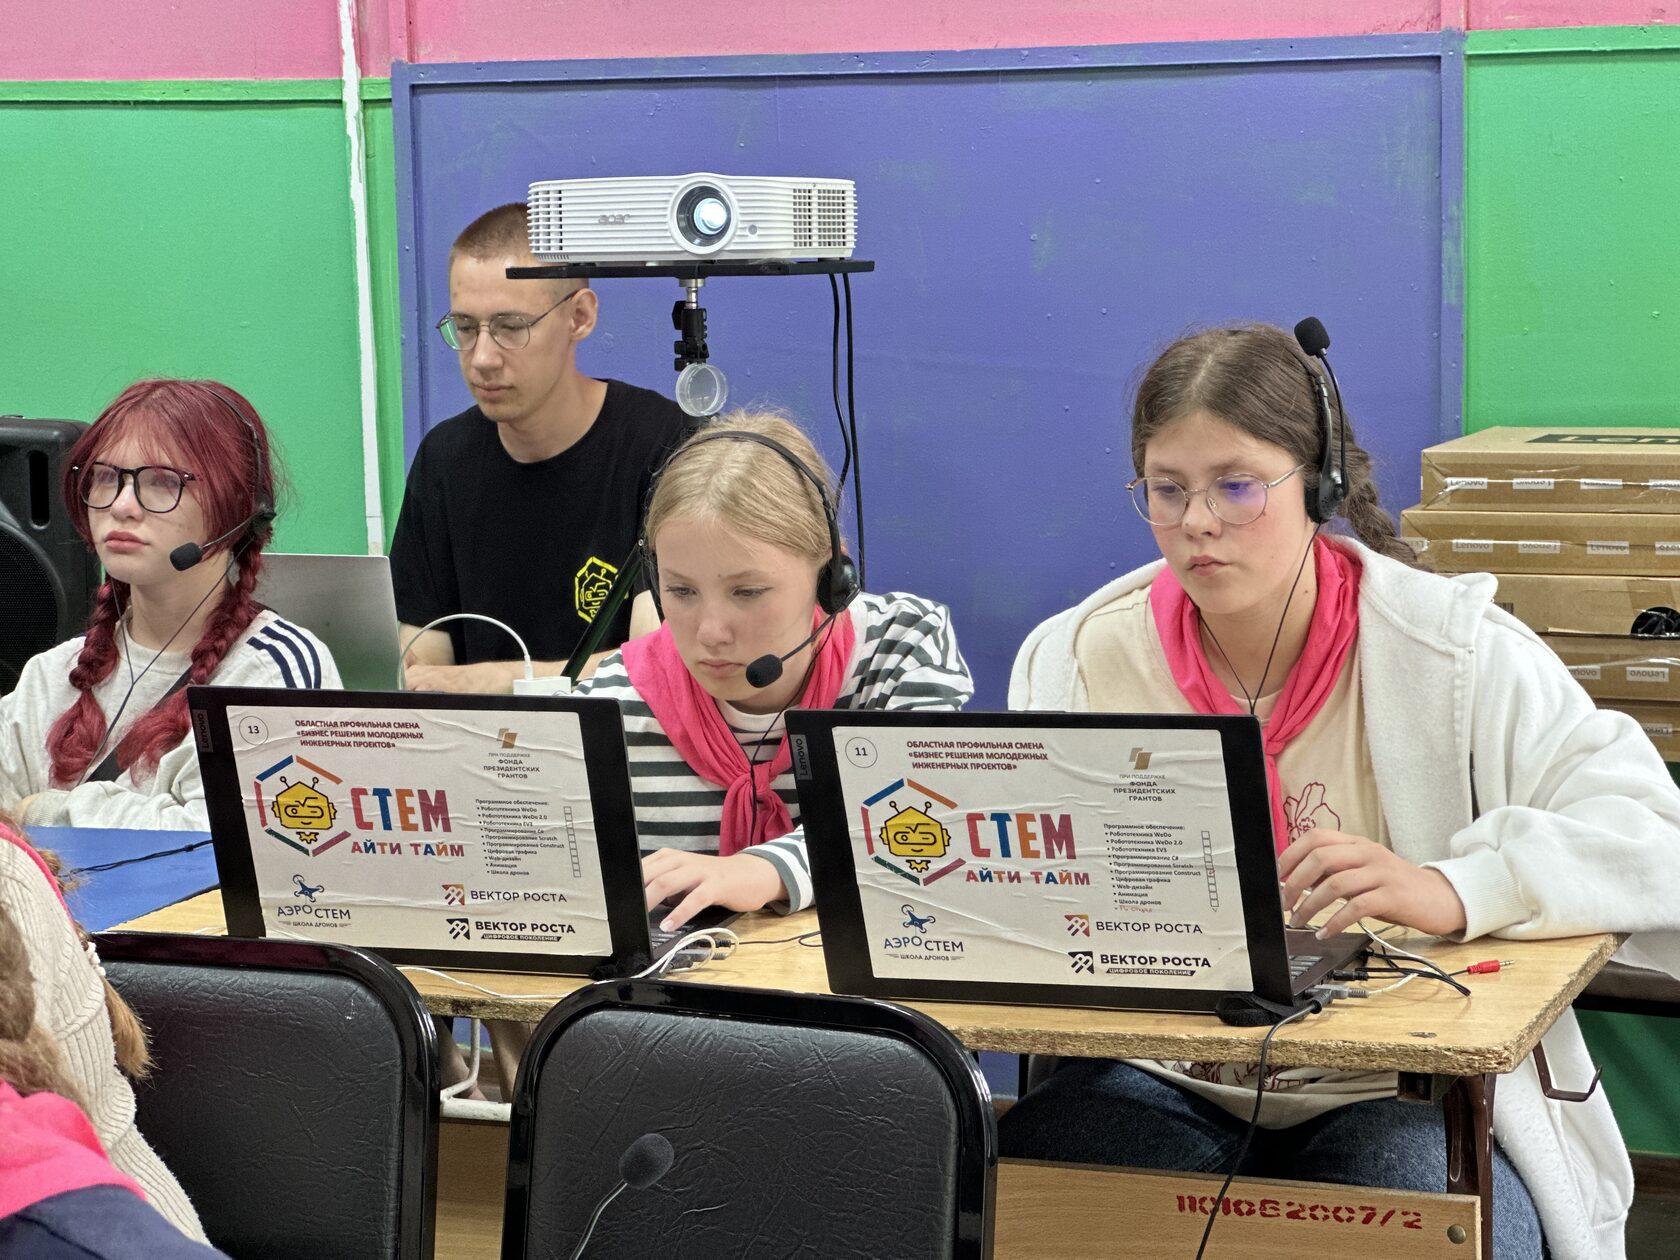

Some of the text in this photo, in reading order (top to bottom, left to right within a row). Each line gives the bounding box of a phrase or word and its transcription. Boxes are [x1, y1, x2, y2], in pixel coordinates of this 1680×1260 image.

[598, 214, 631, 225] acer
[1455, 541, 1490, 550] Lenovo
[1630, 669, 1666, 679] Lenovo
[248, 725, 260, 734] 13
[294, 720, 338, 728] ОБЛАСТНАЯ
[330, 730, 366, 738] РЕШЕНИЯ
[796, 738, 808, 776] Lenovo
[855, 747, 868, 756] 11
[986, 752, 1048, 760] МОЛОДЕЖНЫХ
[350, 787, 452, 832] СТЕМ
[966, 813, 1076, 859] СТЕМ
[351, 839, 465, 857] АЙТИ ТАЙМ
[966, 867, 1090, 885] АЙТИ ТАЙМ
[470, 890, 568, 902] ВЕКТОР РОСТА
[475, 921, 576, 933] ВЕКТОР РОСТА
[1096, 921, 1203, 934] ВЕКТОР РОСТА
[1100, 954, 1211, 968] ВЕКТОР РОСТА
